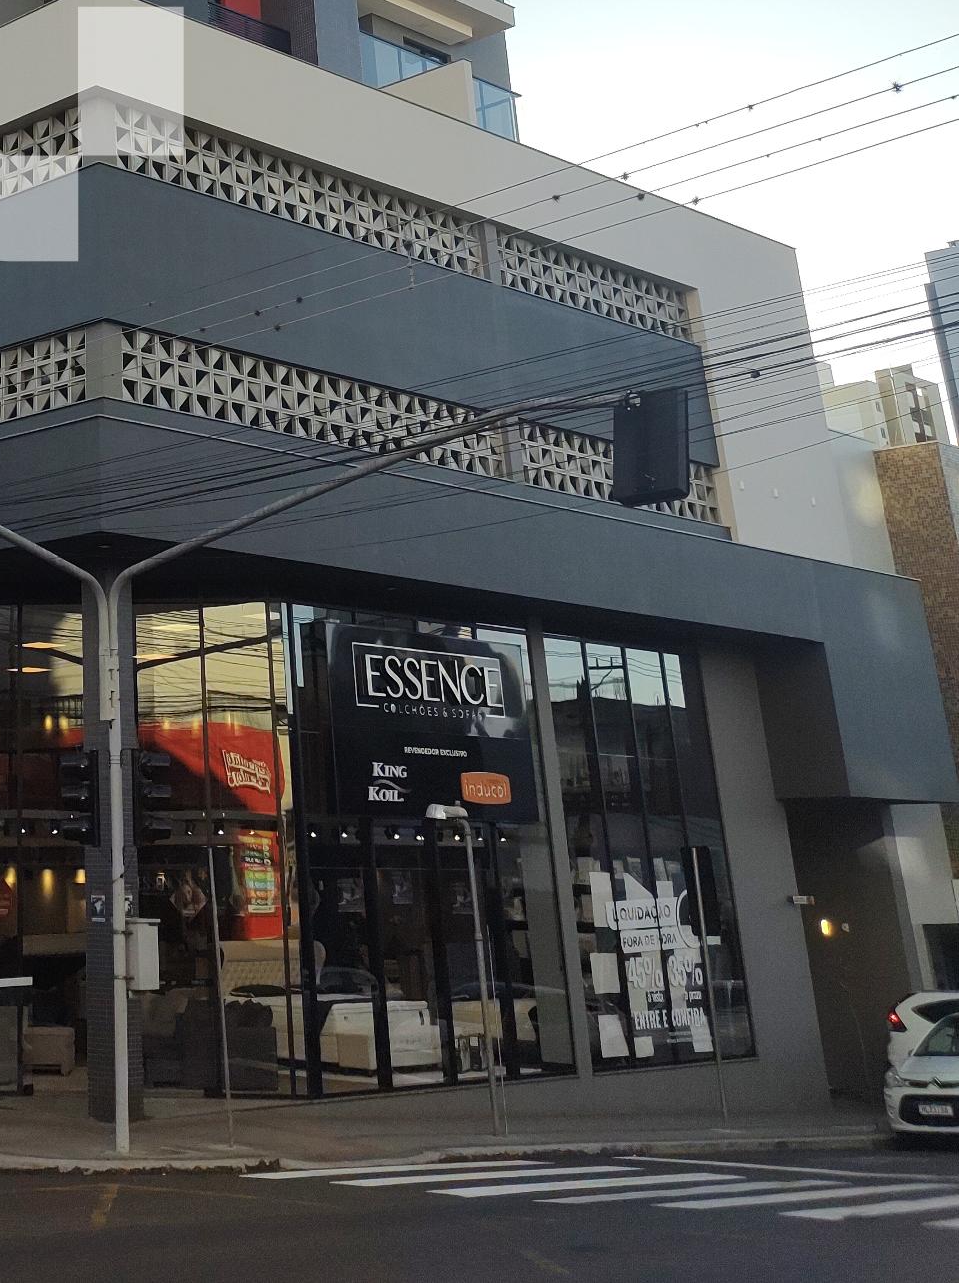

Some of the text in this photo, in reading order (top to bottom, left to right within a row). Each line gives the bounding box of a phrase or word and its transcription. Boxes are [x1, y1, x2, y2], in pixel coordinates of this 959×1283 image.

[365, 653, 503, 708] ESSENCE
[384, 703, 438, 717] COLCHÕES
[372, 762, 408, 778] KING
[464, 779, 507, 799] inducol
[657, 933, 677, 945] ORA
